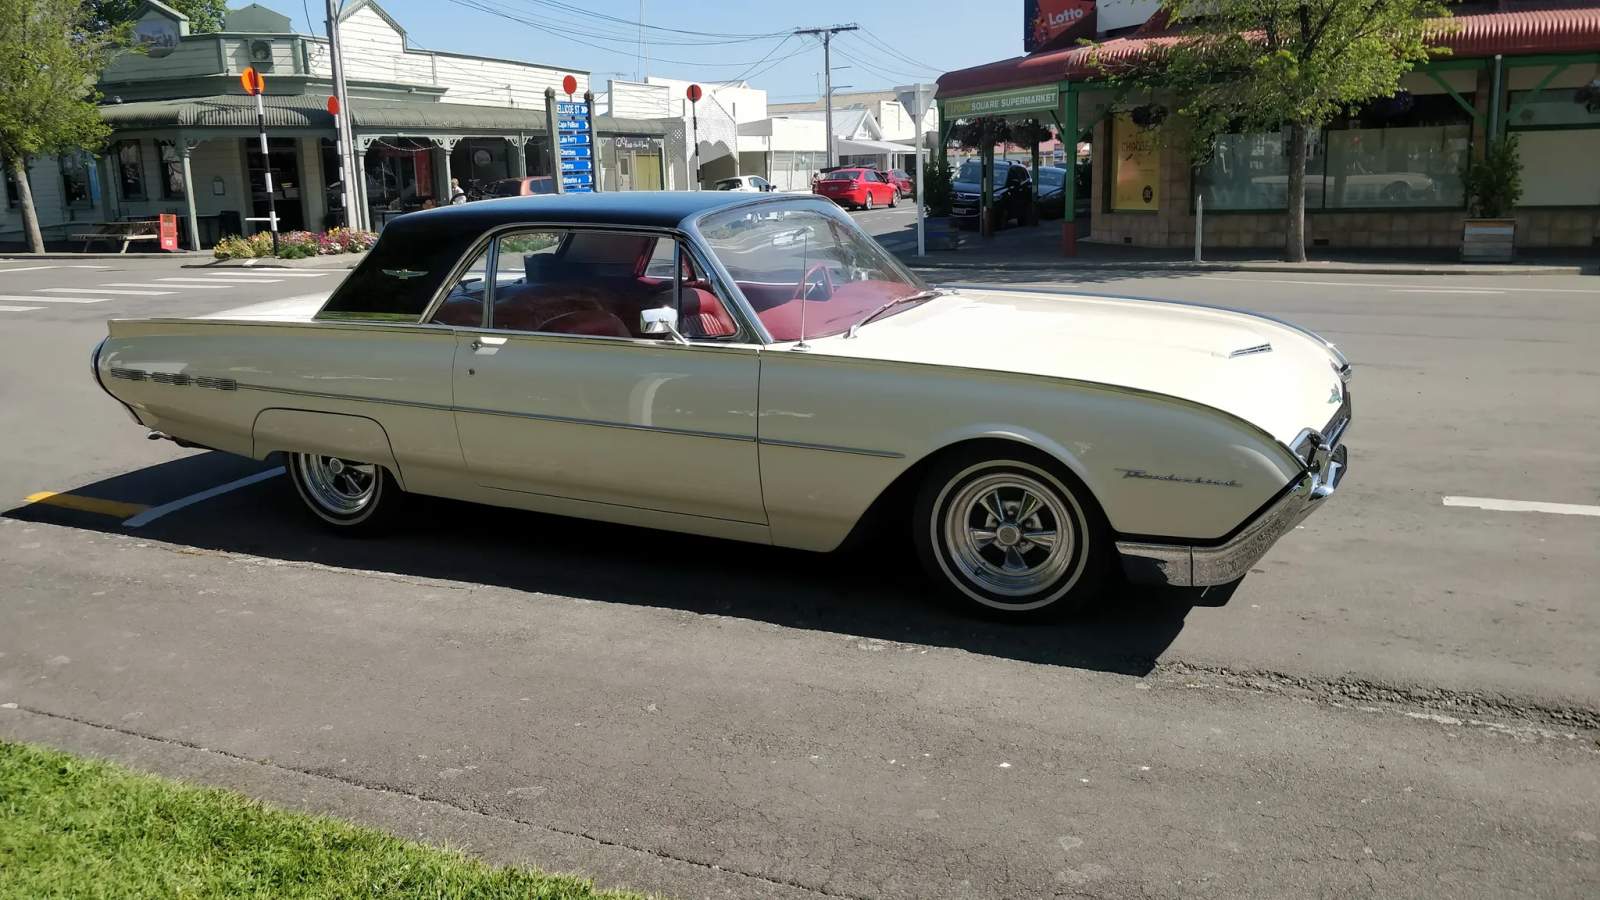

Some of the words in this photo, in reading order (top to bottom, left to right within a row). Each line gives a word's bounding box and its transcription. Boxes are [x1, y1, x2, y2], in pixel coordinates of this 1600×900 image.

[1048, 8, 1083, 25] Lotto
[971, 99, 1000, 111] SQUARE
[1001, 92, 1057, 107] SUPERMARKET
